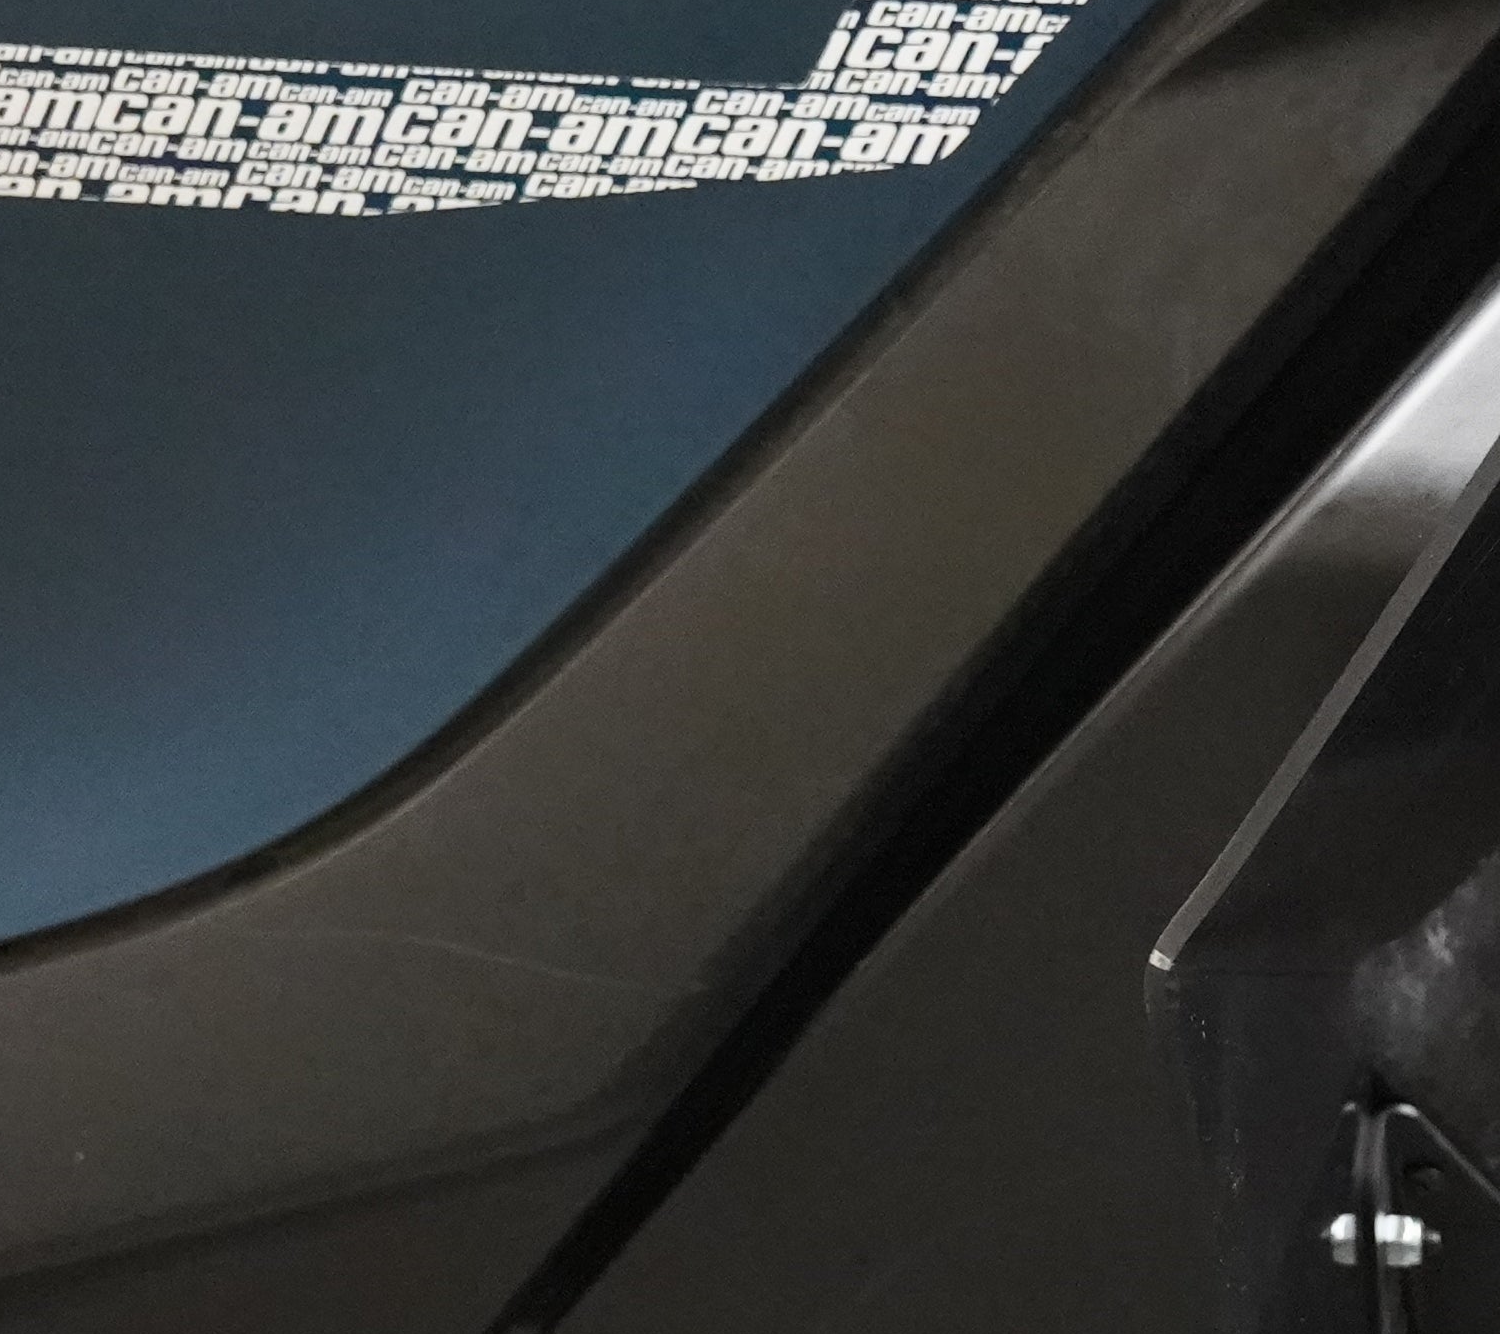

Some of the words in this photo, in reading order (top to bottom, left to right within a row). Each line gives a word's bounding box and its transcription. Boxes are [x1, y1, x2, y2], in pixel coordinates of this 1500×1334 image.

[113, 64, 284, 100] can-am
[400, 77, 575, 111] can-am
[692, 87, 869, 121] can-am
[833, 68, 1001, 99] can-am
[96, 90, 385, 146] can-am
[381, 103, 677, 157] can-am
[87, 131, 247, 163] can-am
[372, 144, 536, 175] can-am
[236, 160, 407, 193] can-am
